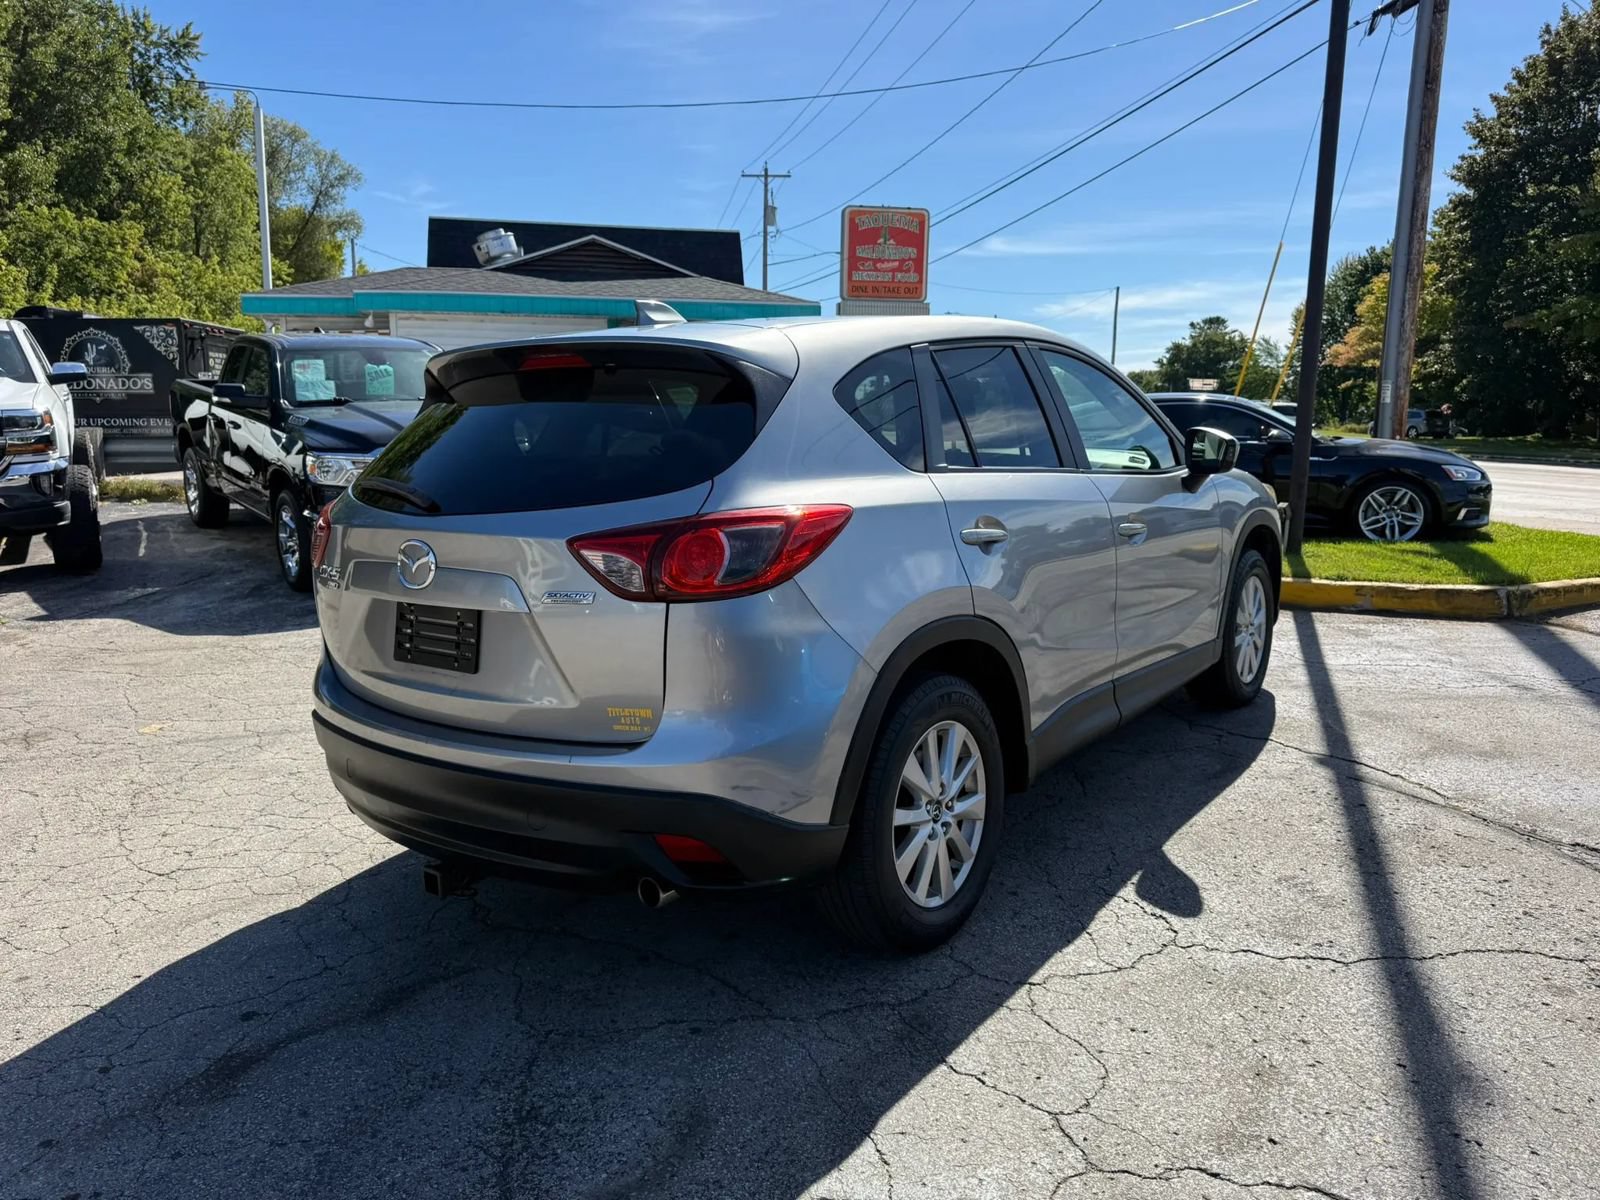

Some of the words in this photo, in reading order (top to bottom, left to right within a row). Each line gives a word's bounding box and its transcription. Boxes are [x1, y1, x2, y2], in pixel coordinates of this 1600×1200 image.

[856, 212, 920, 233] TAQUERIA
[852, 271, 893, 282] MEXICAN
[894, 272, 919, 283] FOOD
[851, 285, 869, 293] DINE
[883, 286, 901, 294] TAKE
[903, 287, 919, 295] OUT
[86, 366, 117, 374] QUERIA
[367, 368, 392, 382] SALE
[69, 377, 153, 390] DONADO'S
[74, 418, 88, 426] UR
[90, 418, 148, 427] UPCOMING
